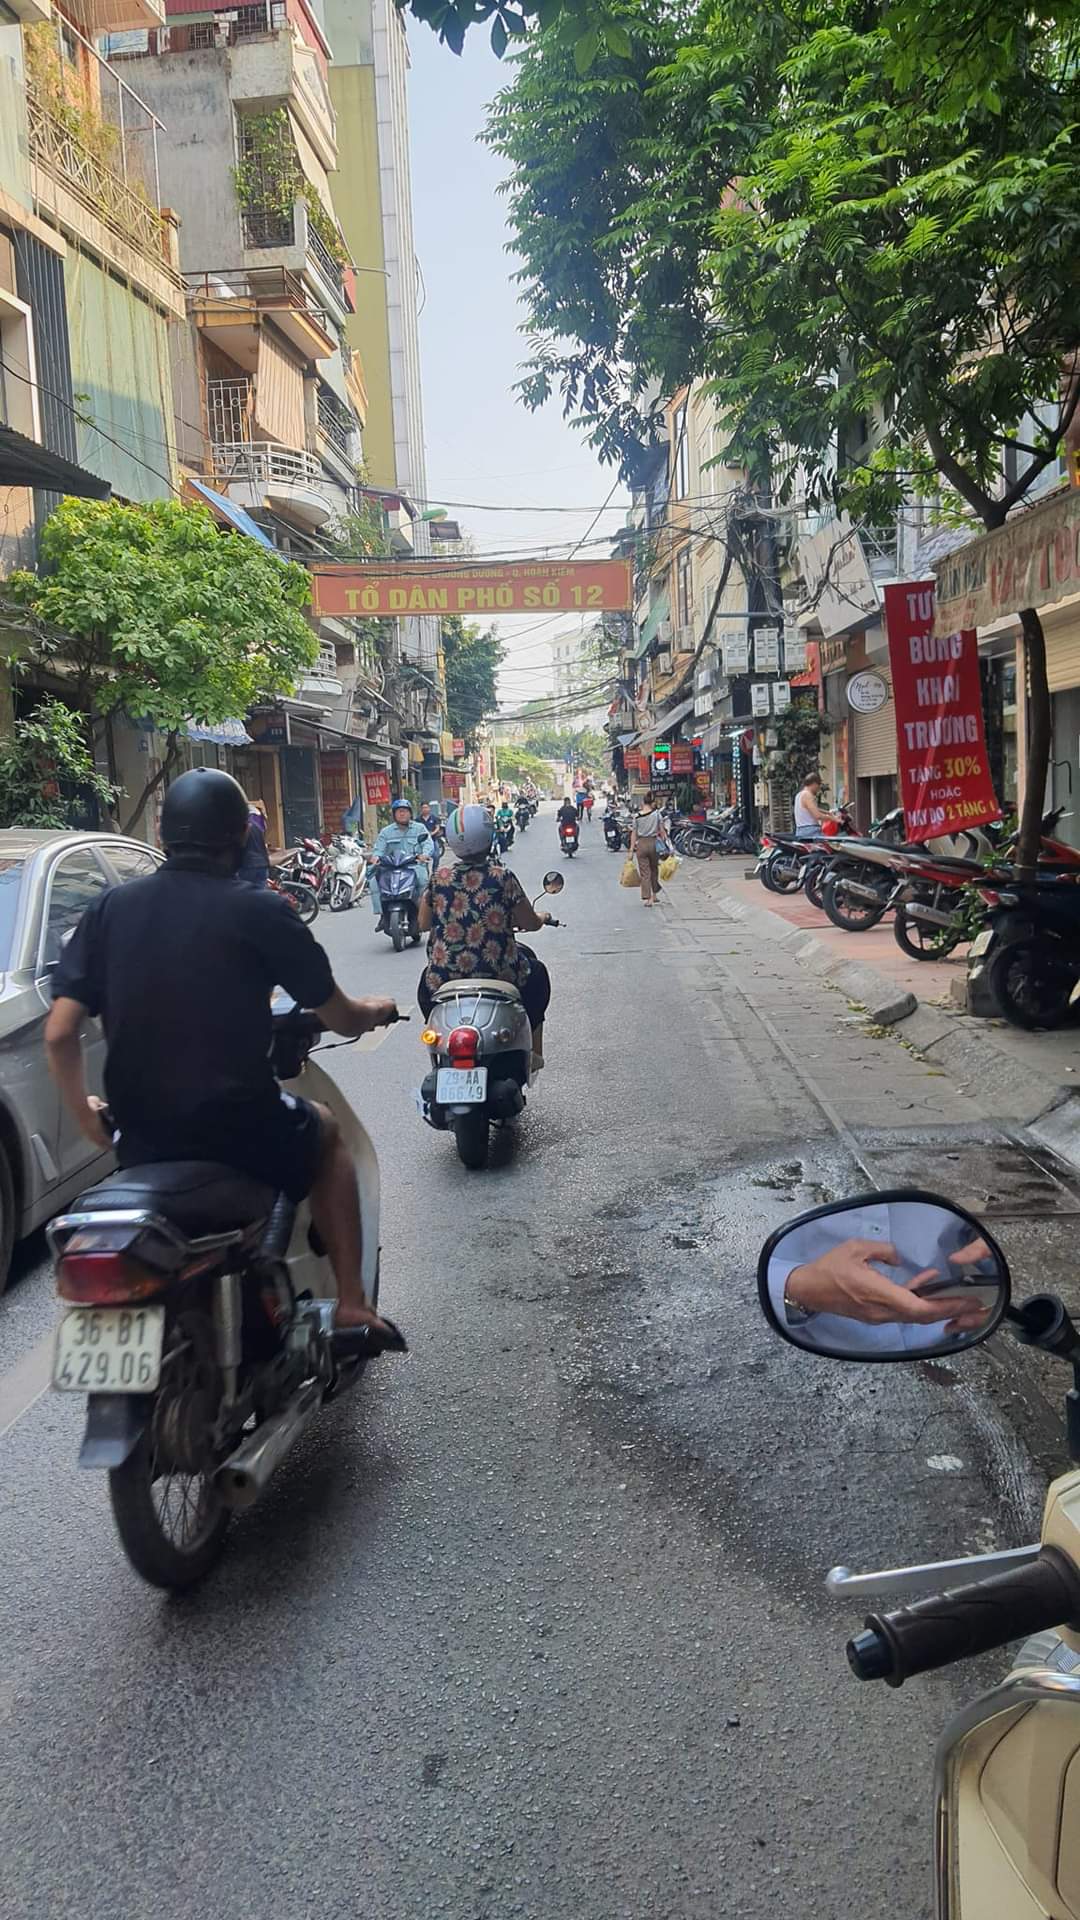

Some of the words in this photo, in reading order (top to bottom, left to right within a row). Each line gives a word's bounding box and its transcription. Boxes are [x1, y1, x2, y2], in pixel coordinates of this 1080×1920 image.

[345, 581, 380, 610] TỔ
[389, 584, 448, 609] DÂN
[458, 579, 514, 609] PHỐ
[523, 578, 561, 607] SỐ
[570, 585, 604, 605] 12
[916, 674, 959, 706] KHAI
[944, 755, 981, 778] 30%
[947, 804, 955, 820] 2
[72, 1311, 146, 1347] 36-B1
[60, 1351, 152, 1385] 429.06
